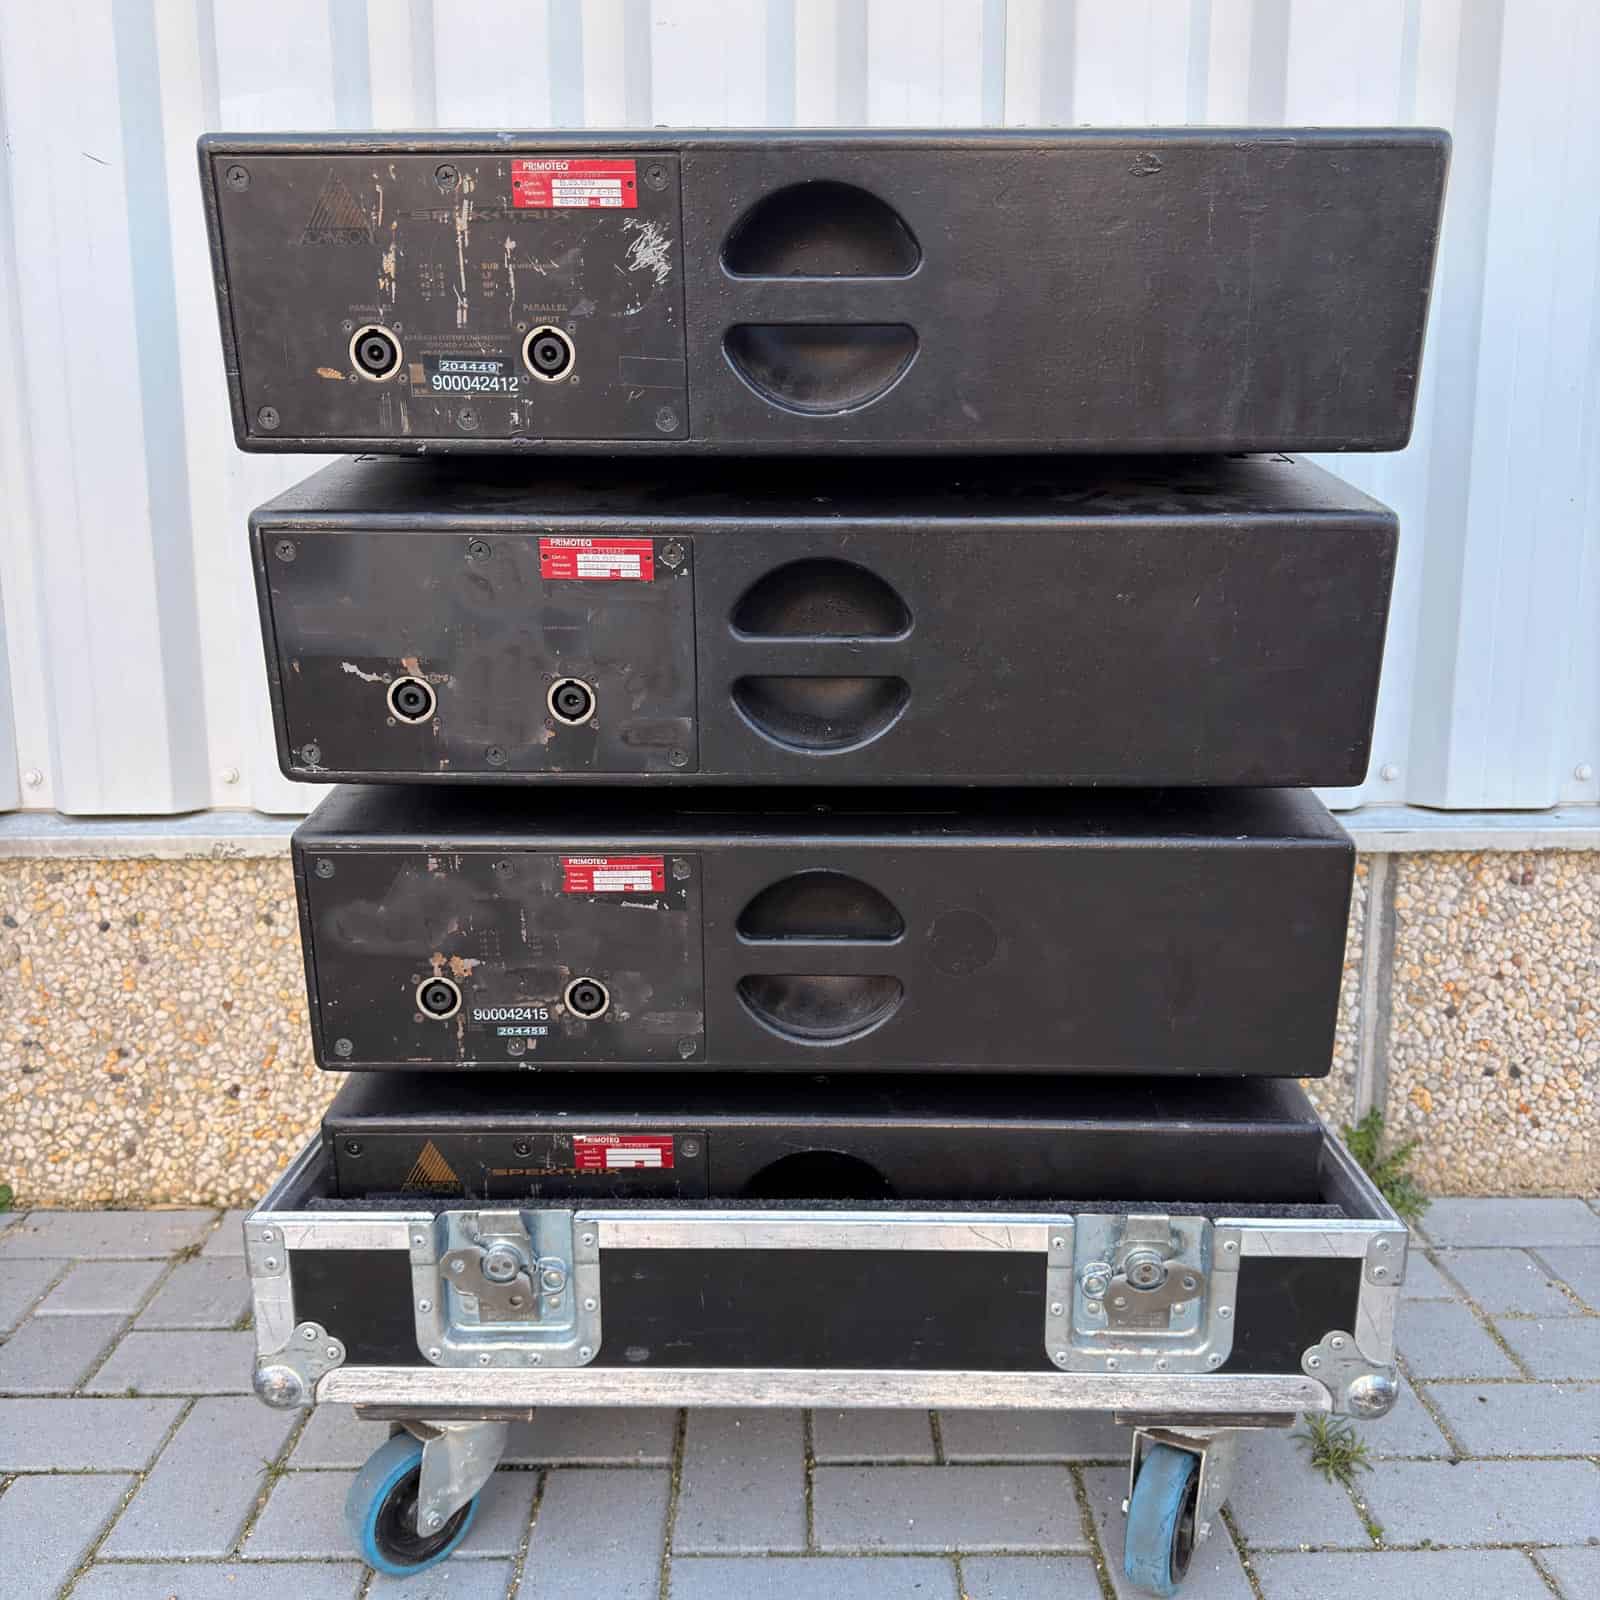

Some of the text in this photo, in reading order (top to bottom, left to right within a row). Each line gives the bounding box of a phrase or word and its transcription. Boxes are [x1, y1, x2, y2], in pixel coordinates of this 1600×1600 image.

[522, 161, 569, 171] PRIMOTEQ
[431, 375, 519, 392] 900042412
[473, 1007, 549, 1021] 900042415
